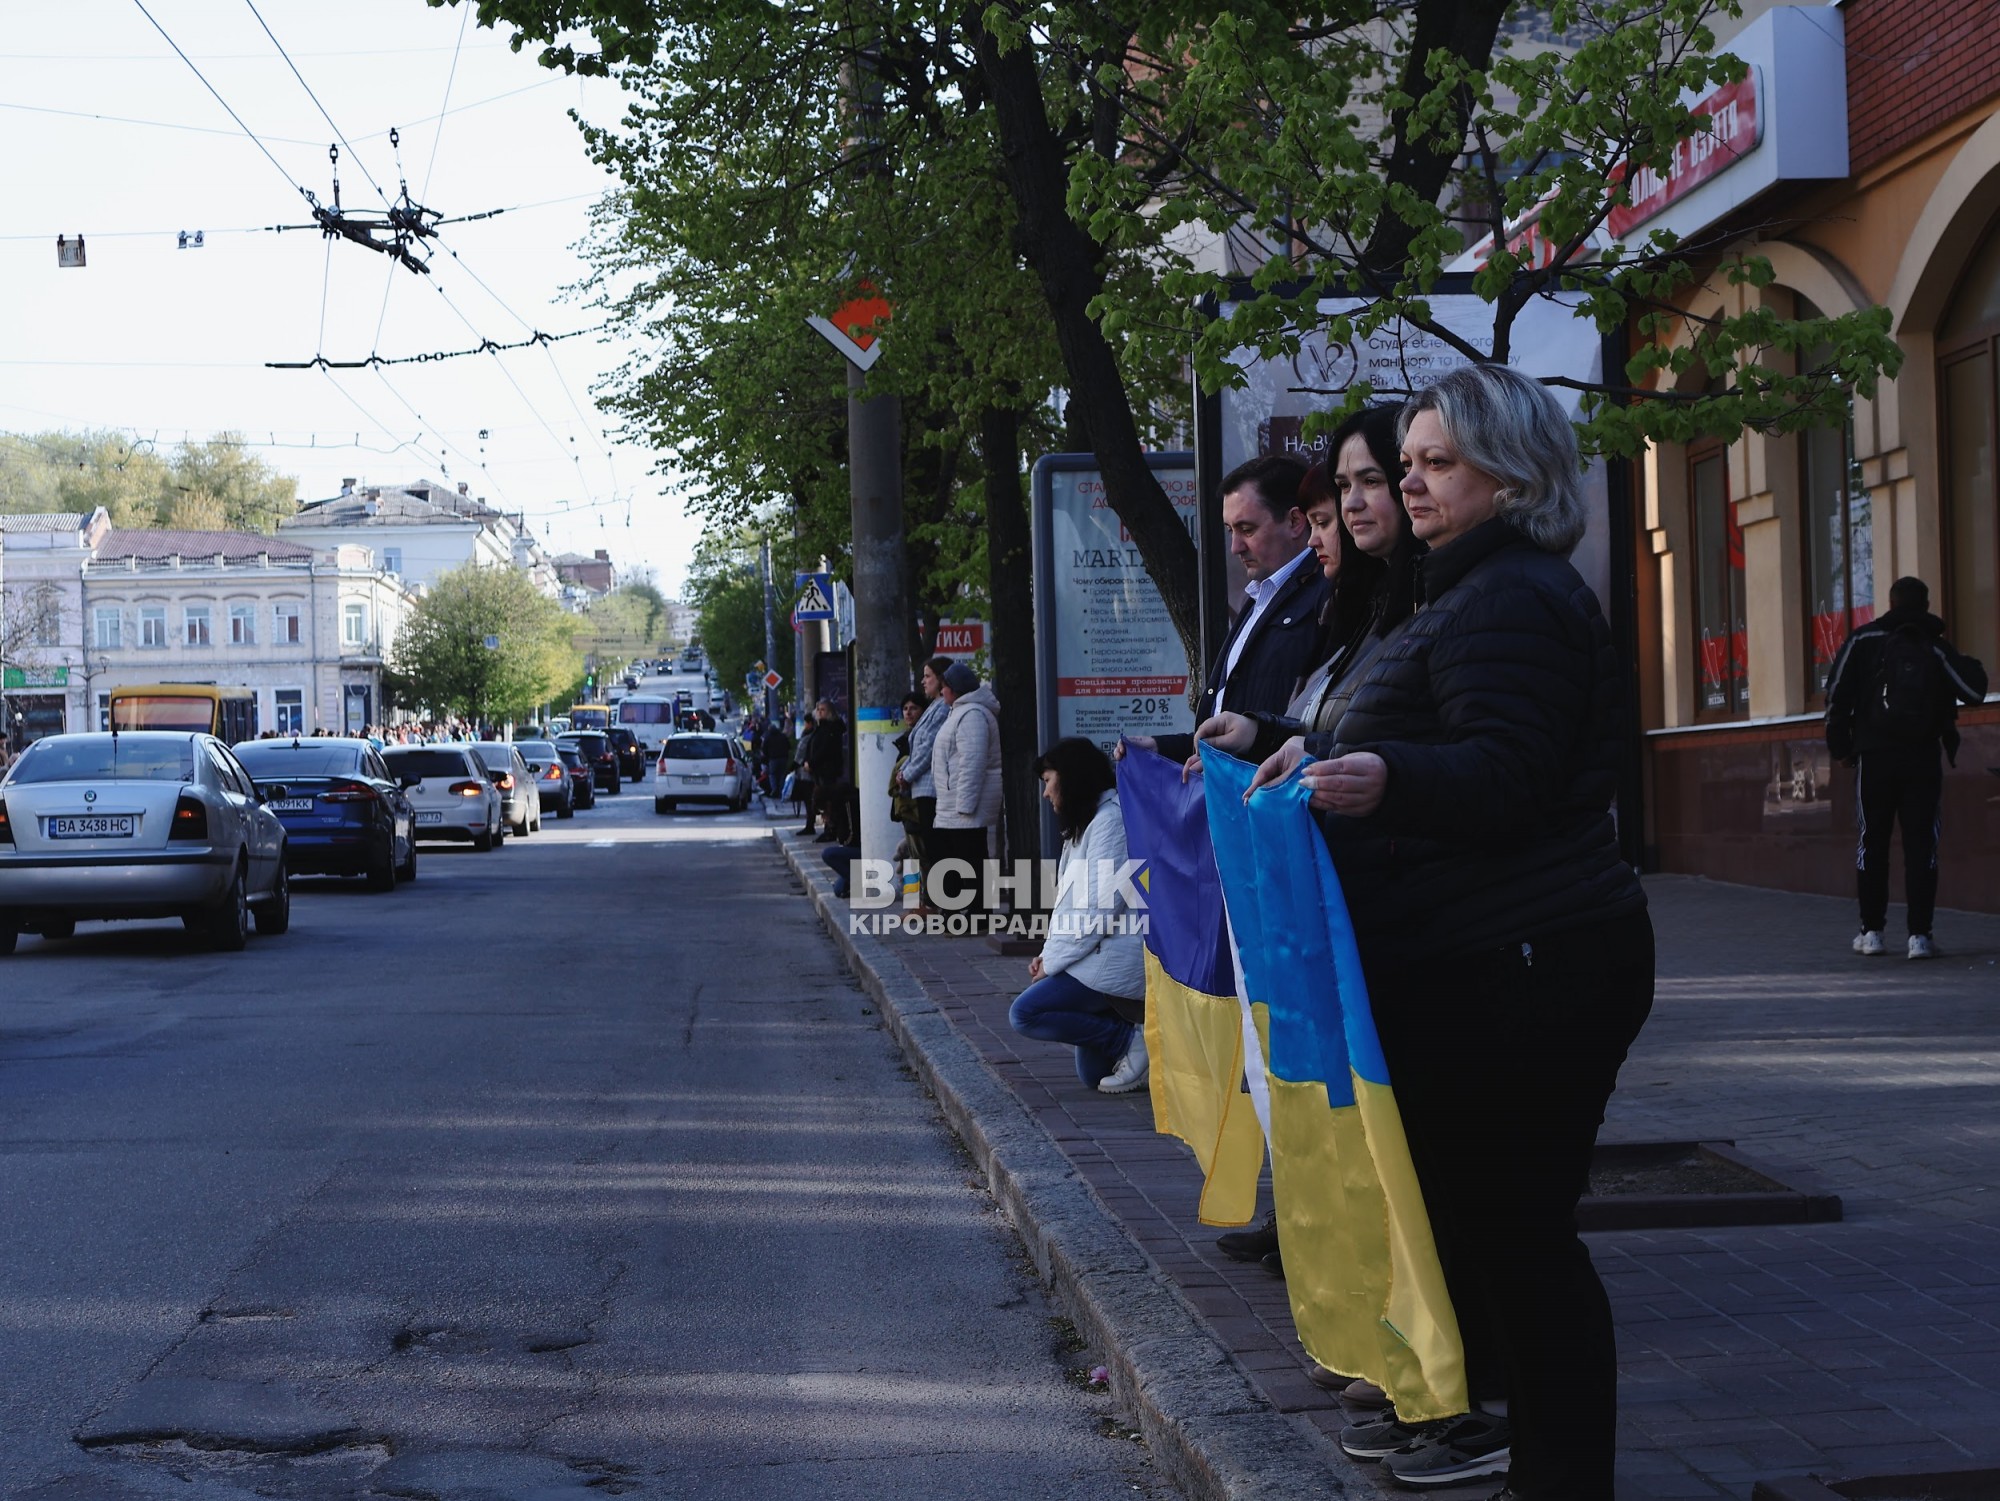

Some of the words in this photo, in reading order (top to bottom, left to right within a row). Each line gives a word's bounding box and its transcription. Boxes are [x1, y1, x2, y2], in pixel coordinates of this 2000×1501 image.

[1438, 357, 1453, 366] та
[1078, 482, 1106, 494] СТА
[1161, 481, 1183, 492] ОЮ
[1073, 550, 1147, 568] MARI
[1073, 577, 1092, 586] Чому
[1074, 678, 1126, 686] Спеціальна
[1131, 677, 1183, 687] пропозиція
[1126, 686, 1172, 694] клієнтів!
[58, 819, 76, 833] BA
[79, 819, 108, 832] 3438
[110, 818, 128, 831] HC
